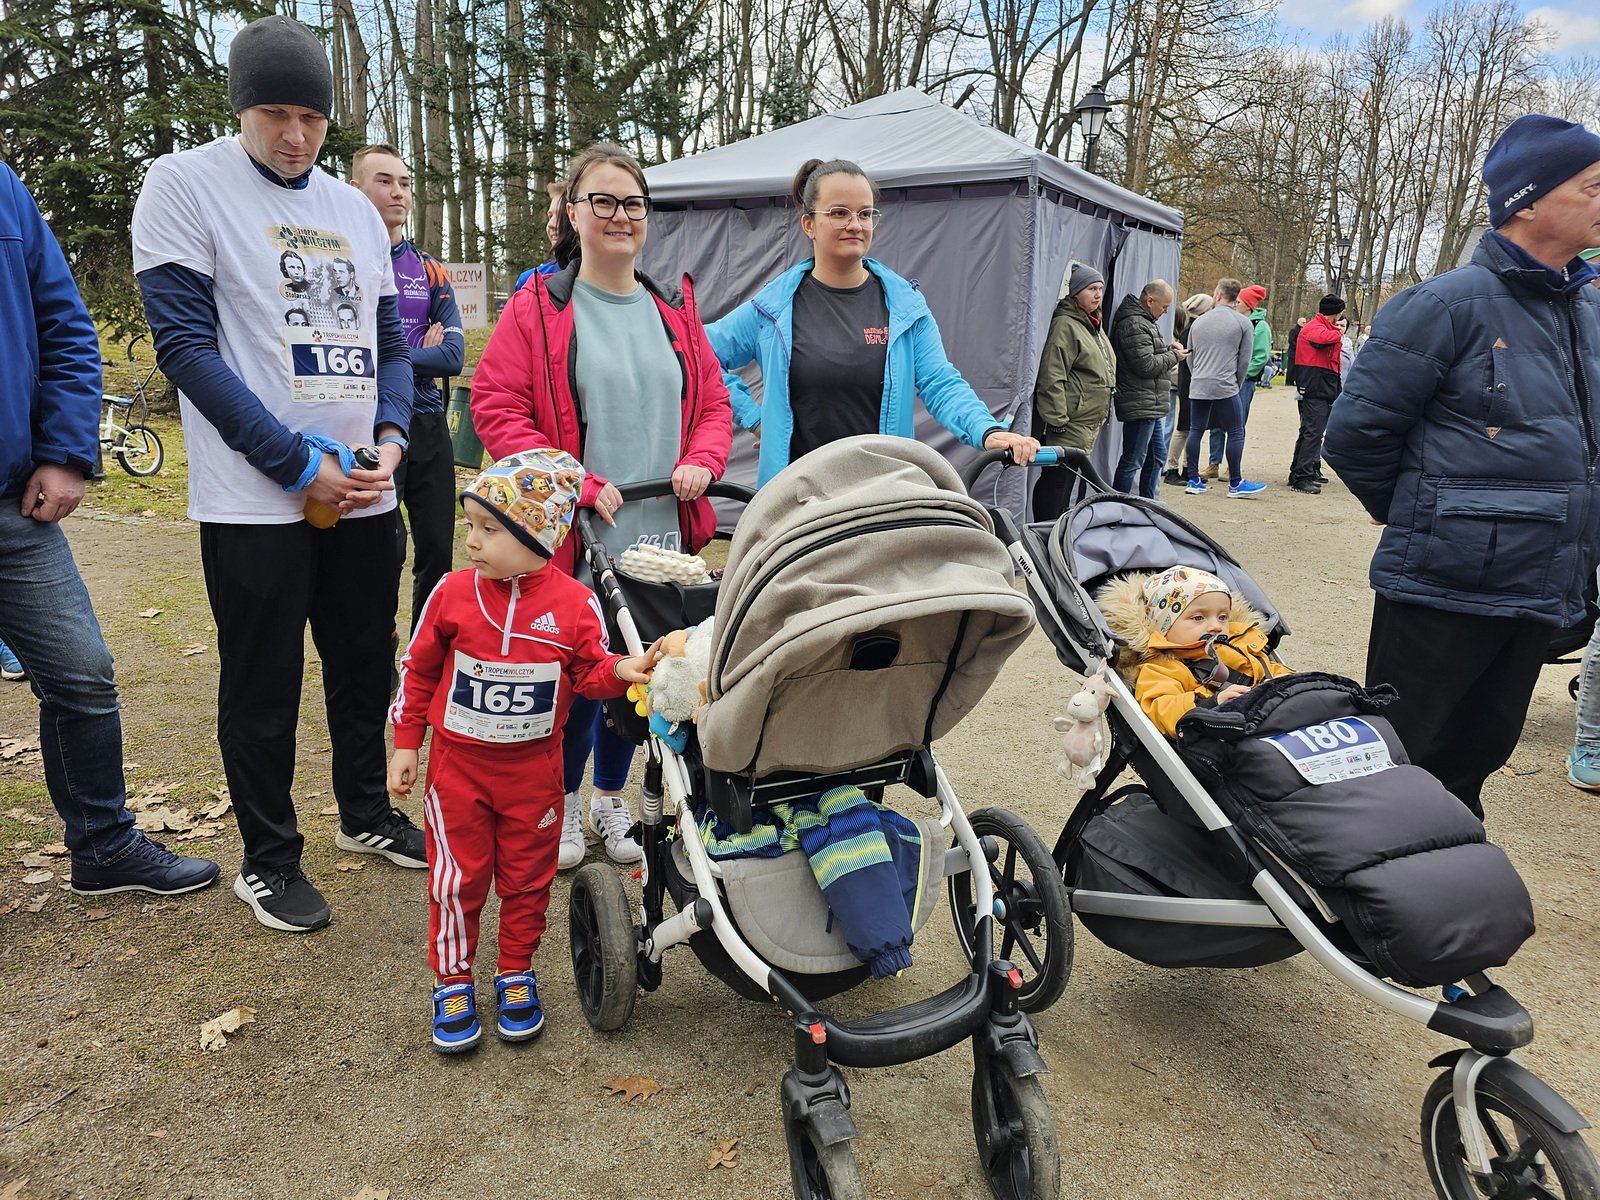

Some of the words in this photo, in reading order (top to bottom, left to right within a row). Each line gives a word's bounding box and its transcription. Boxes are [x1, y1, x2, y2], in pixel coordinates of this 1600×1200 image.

[1504, 183, 1534, 208] BASRY
[300, 235, 341, 249] WILCZYM
[311, 347, 365, 375] 166
[1018, 555, 1033, 576] THULE
[530, 622, 560, 634] adidas
[469, 680, 535, 713] 165
[1288, 721, 1359, 753] 180
[537, 815, 558, 829] adidas
